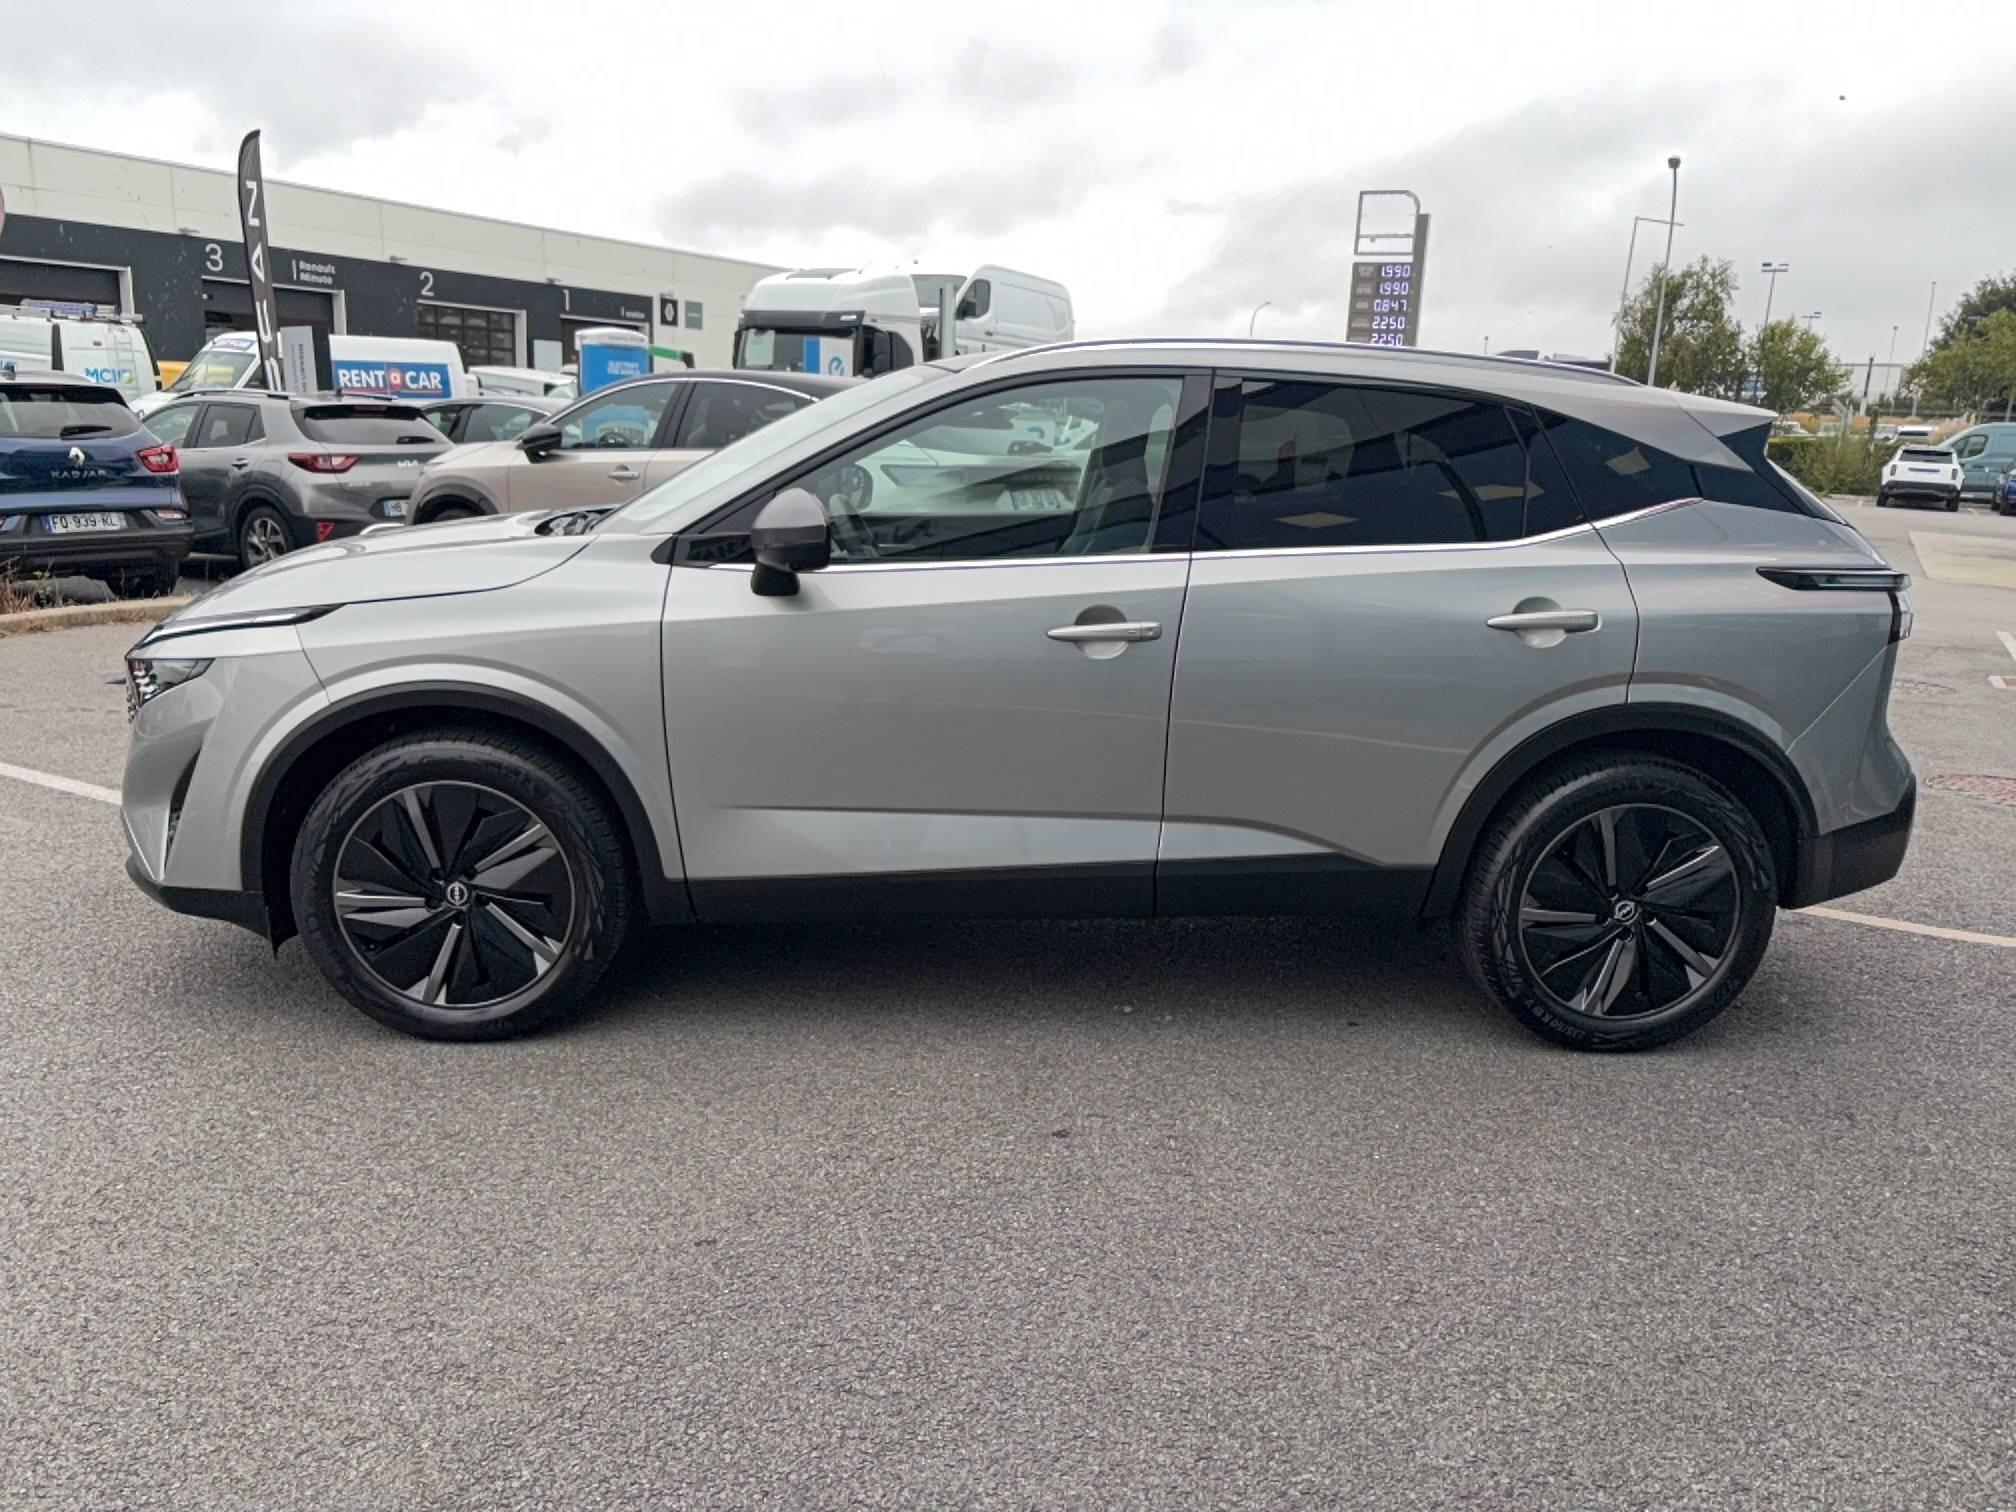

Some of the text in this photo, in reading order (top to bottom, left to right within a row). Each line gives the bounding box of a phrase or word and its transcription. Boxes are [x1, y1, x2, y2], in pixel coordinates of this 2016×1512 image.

[205, 243, 223, 272] 3
[419, 271, 435, 297] 2
[563, 289, 570, 312] 1
[338, 369, 385, 389] RENT
[405, 371, 442, 389] CAR
[50, 469, 108, 480] KADJAR
